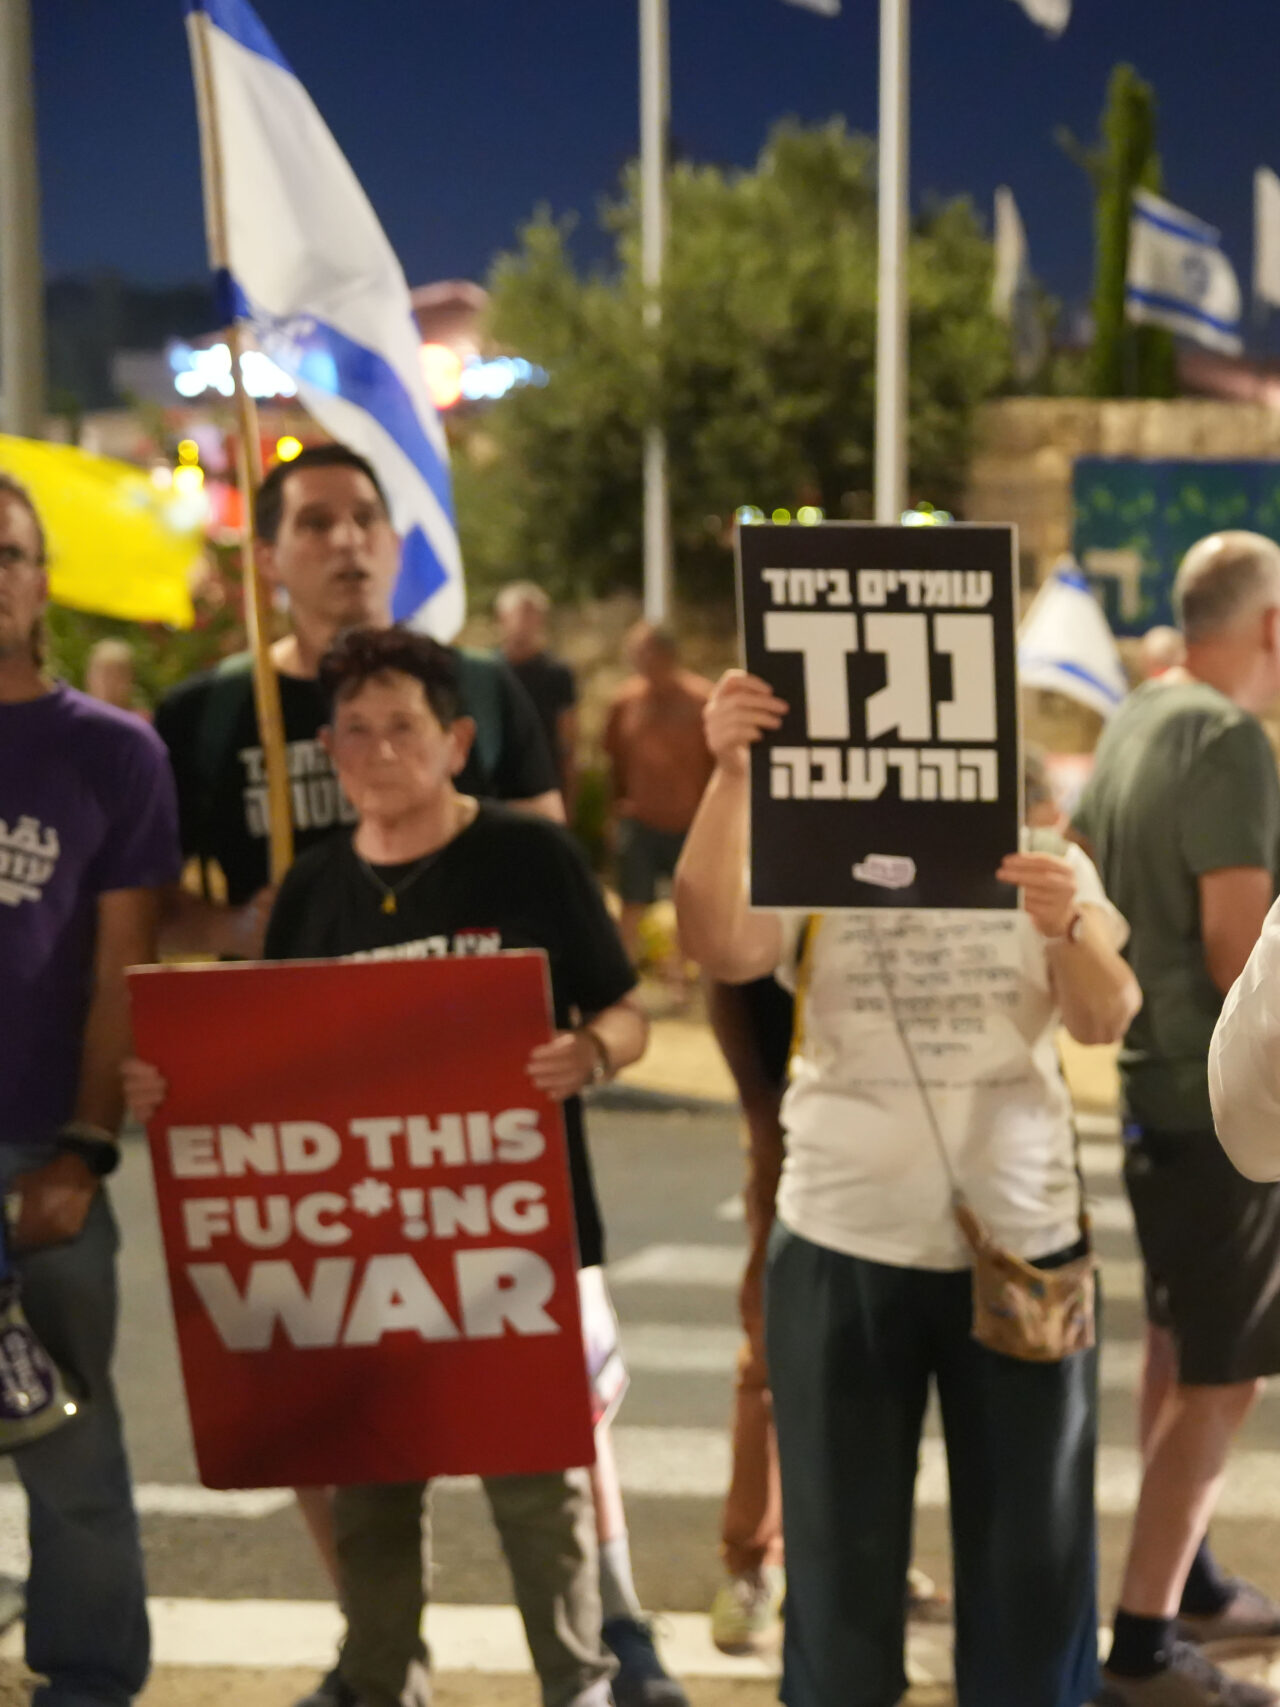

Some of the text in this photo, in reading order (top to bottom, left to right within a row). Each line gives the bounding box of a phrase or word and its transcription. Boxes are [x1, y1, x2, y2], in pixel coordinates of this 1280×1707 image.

[761, 568, 993, 607] עומדים ביחד
[763, 611, 997, 742] נגד
[770, 746, 998, 802] ההרעבה
[167, 1109, 545, 1178] END THIS
[186, 1247, 561, 1352] WAR
